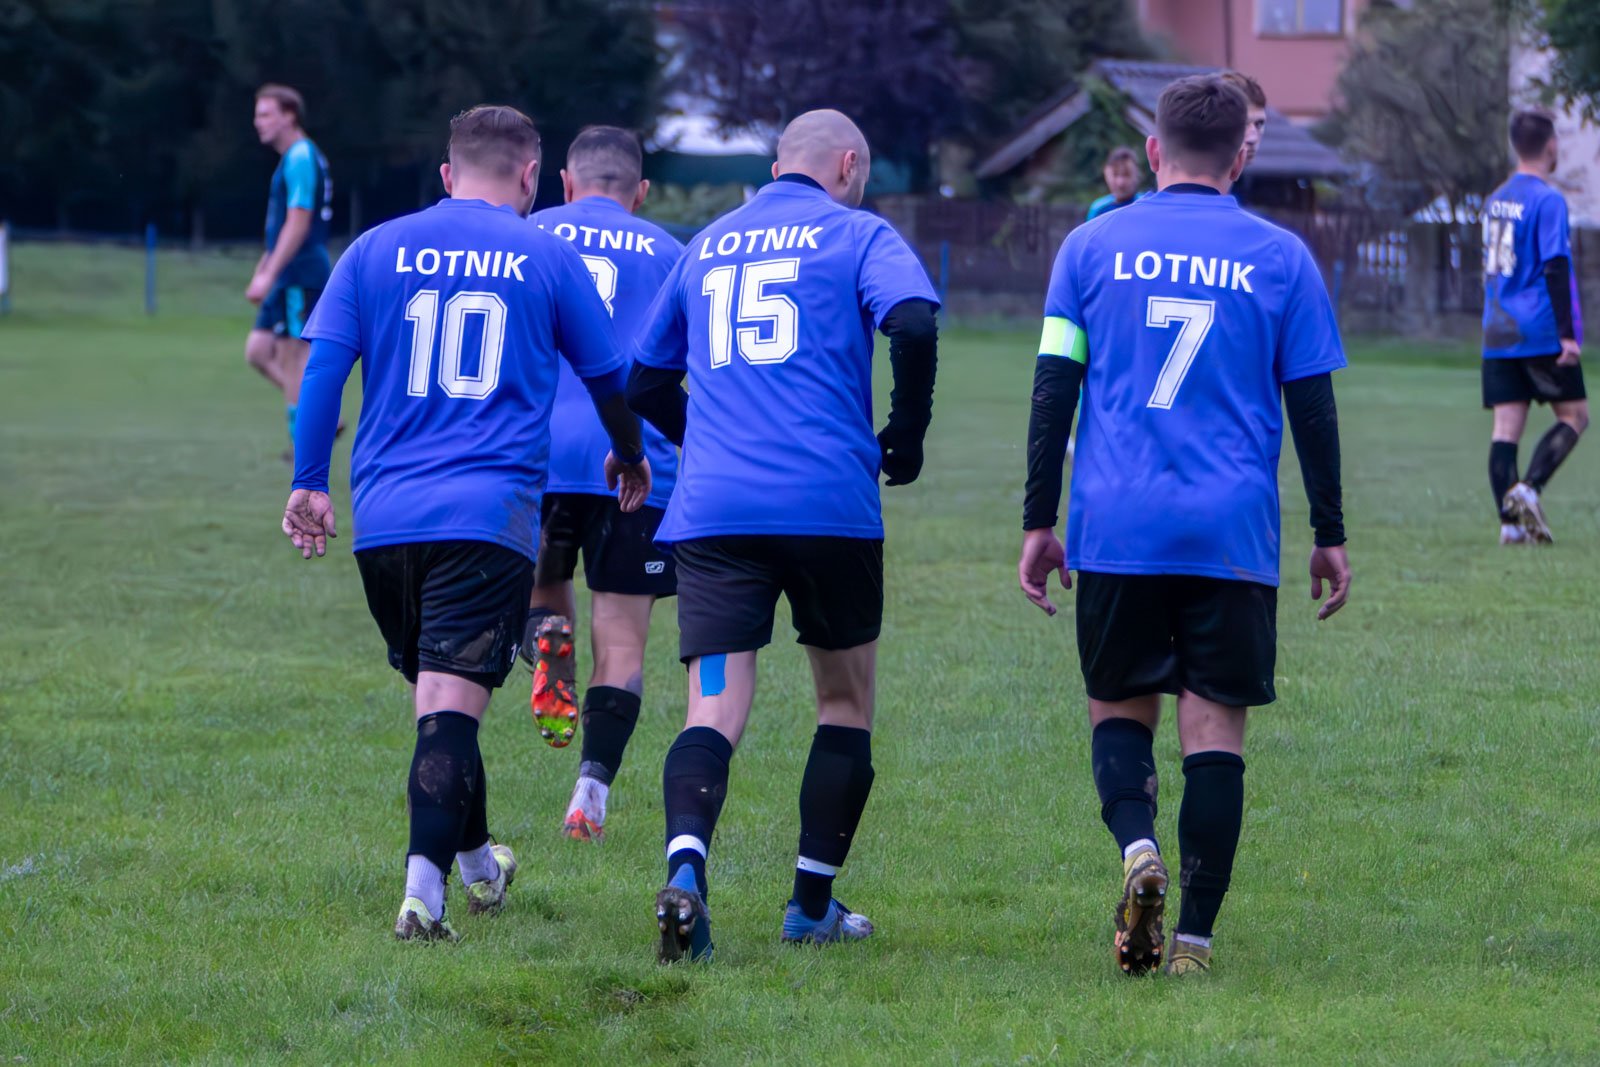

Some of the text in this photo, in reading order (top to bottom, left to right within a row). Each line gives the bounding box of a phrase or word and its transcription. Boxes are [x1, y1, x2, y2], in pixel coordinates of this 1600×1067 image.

[537, 223, 656, 256] OTNIK
[699, 225, 824, 260] LOTNIK
[395, 247, 528, 282] LOTNIK
[1114, 250, 1256, 293] LOTNIK
[701, 257, 801, 370] 15
[404, 289, 508, 400] 10
[1145, 295, 1216, 410] 7
